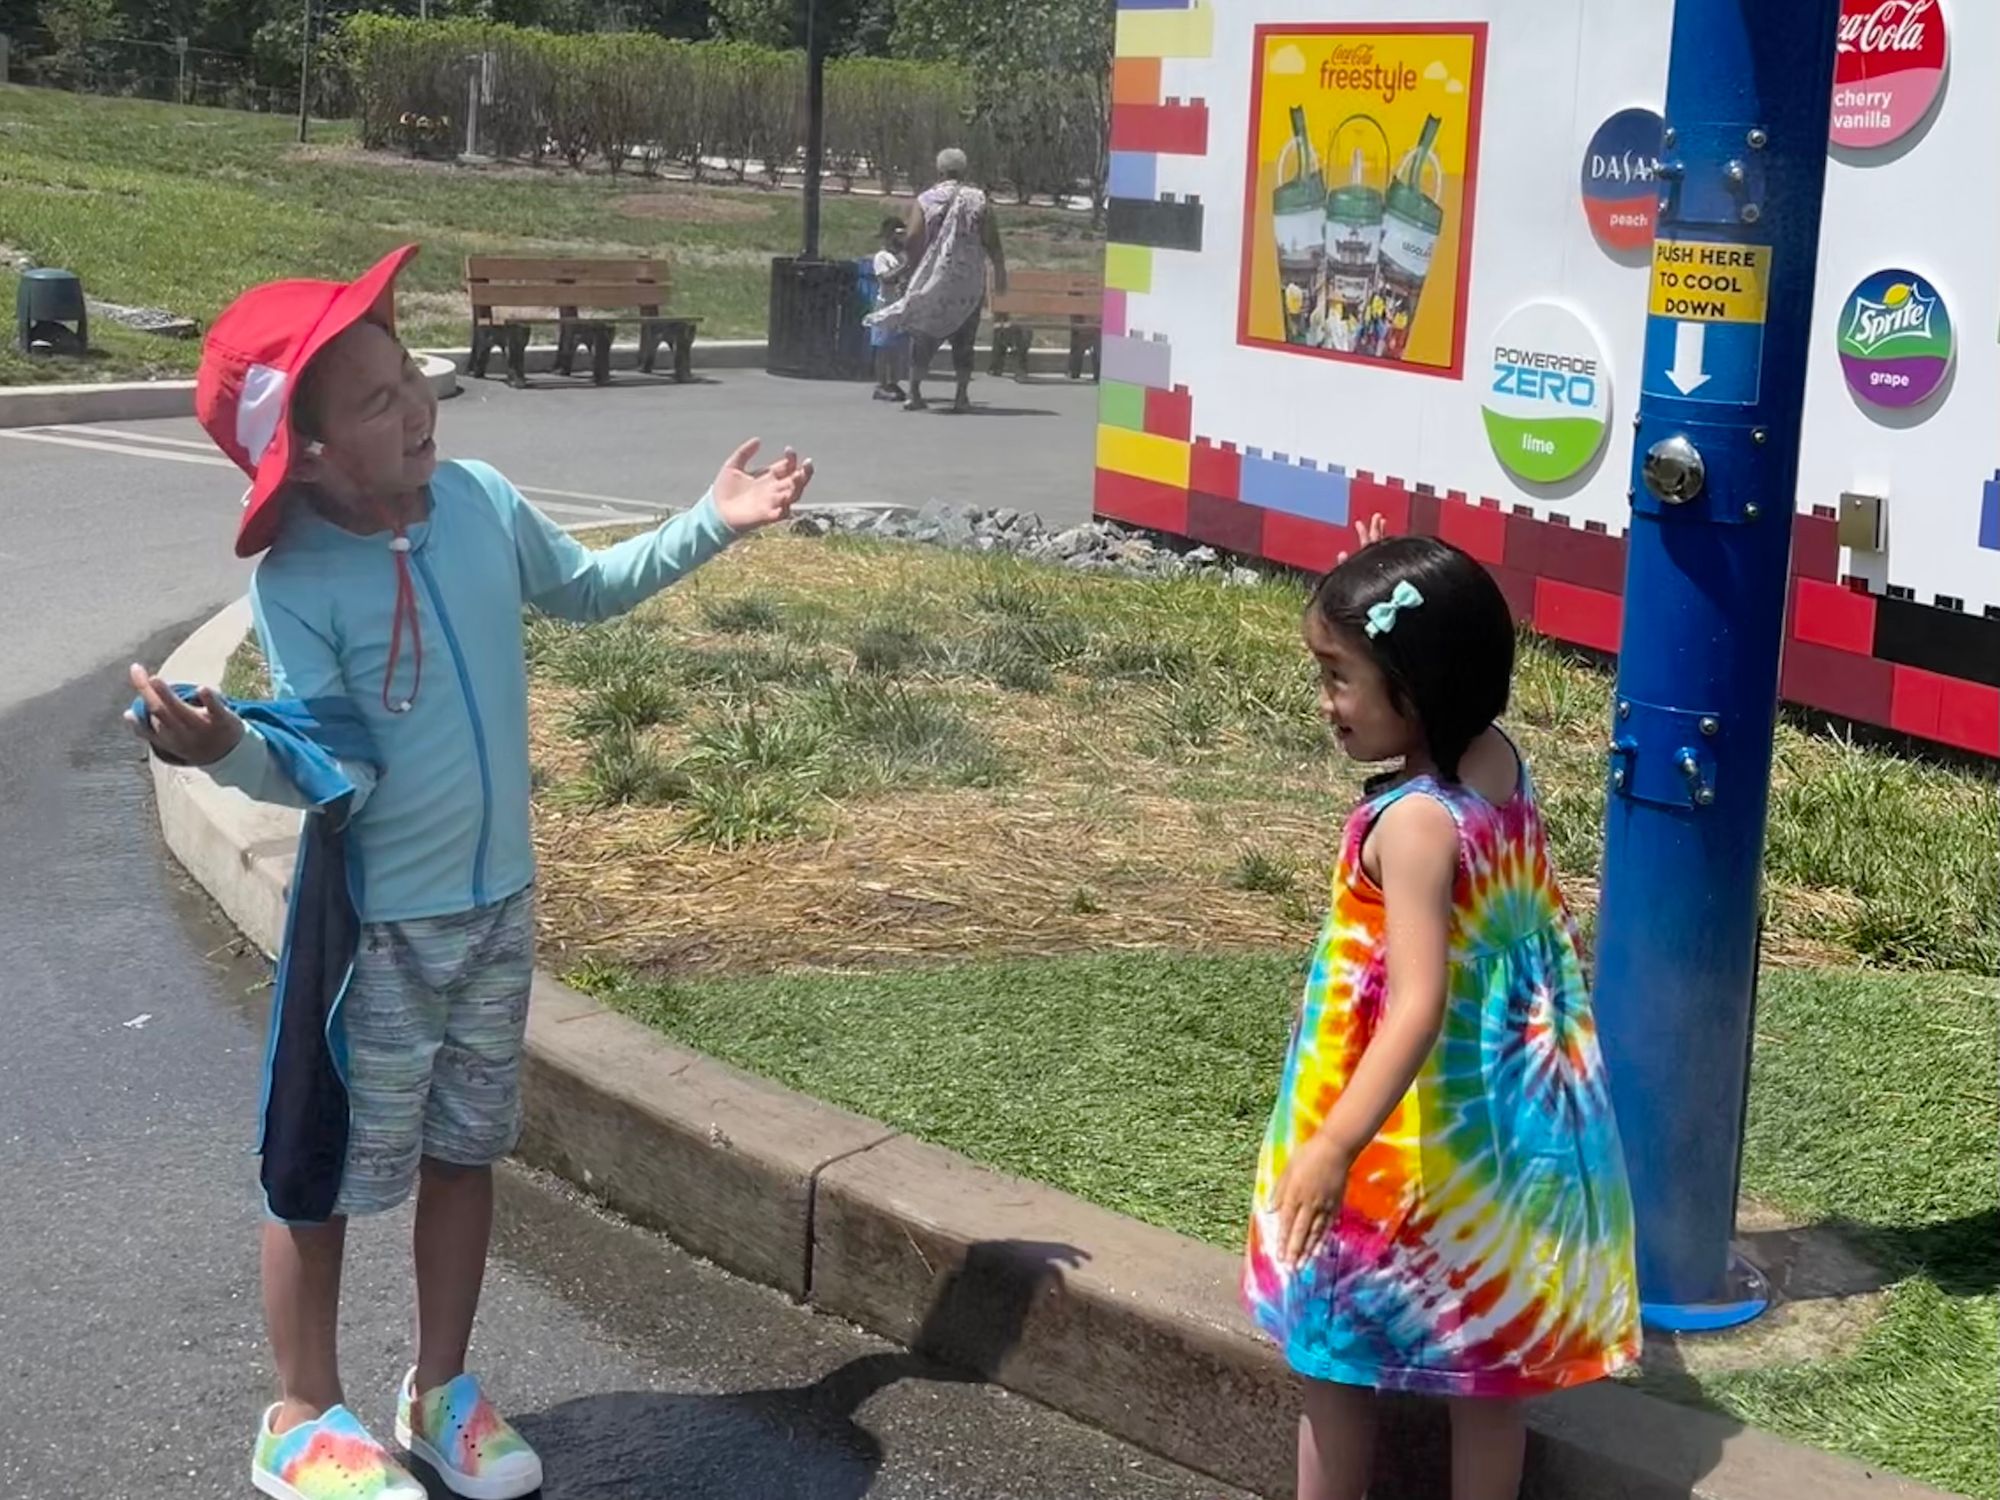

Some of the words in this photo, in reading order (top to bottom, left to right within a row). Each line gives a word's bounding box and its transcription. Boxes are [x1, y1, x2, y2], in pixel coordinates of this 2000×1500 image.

[1838, 0, 1934, 53] ca-Cola
[1320, 60, 1417, 104] freestyle
[1834, 89, 1893, 110] cherry
[1833, 111, 1892, 129] vanilla
[1592, 149, 1659, 185] DASAN
[1609, 213, 1649, 228] peach
[1657, 246, 1694, 263] PUSH
[1700, 249, 1756, 268] HERE
[1660, 271, 1679, 288] TO
[1683, 274, 1743, 293] COOL
[1665, 298, 1726, 317] DOWN
[1855, 297, 1924, 345] Sprite
[1494, 346, 1598, 377] POWERADE
[1492, 363, 1595, 407] ZERO
[1869, 371, 1910, 388] grape
[1522, 432, 1555, 455] lime
